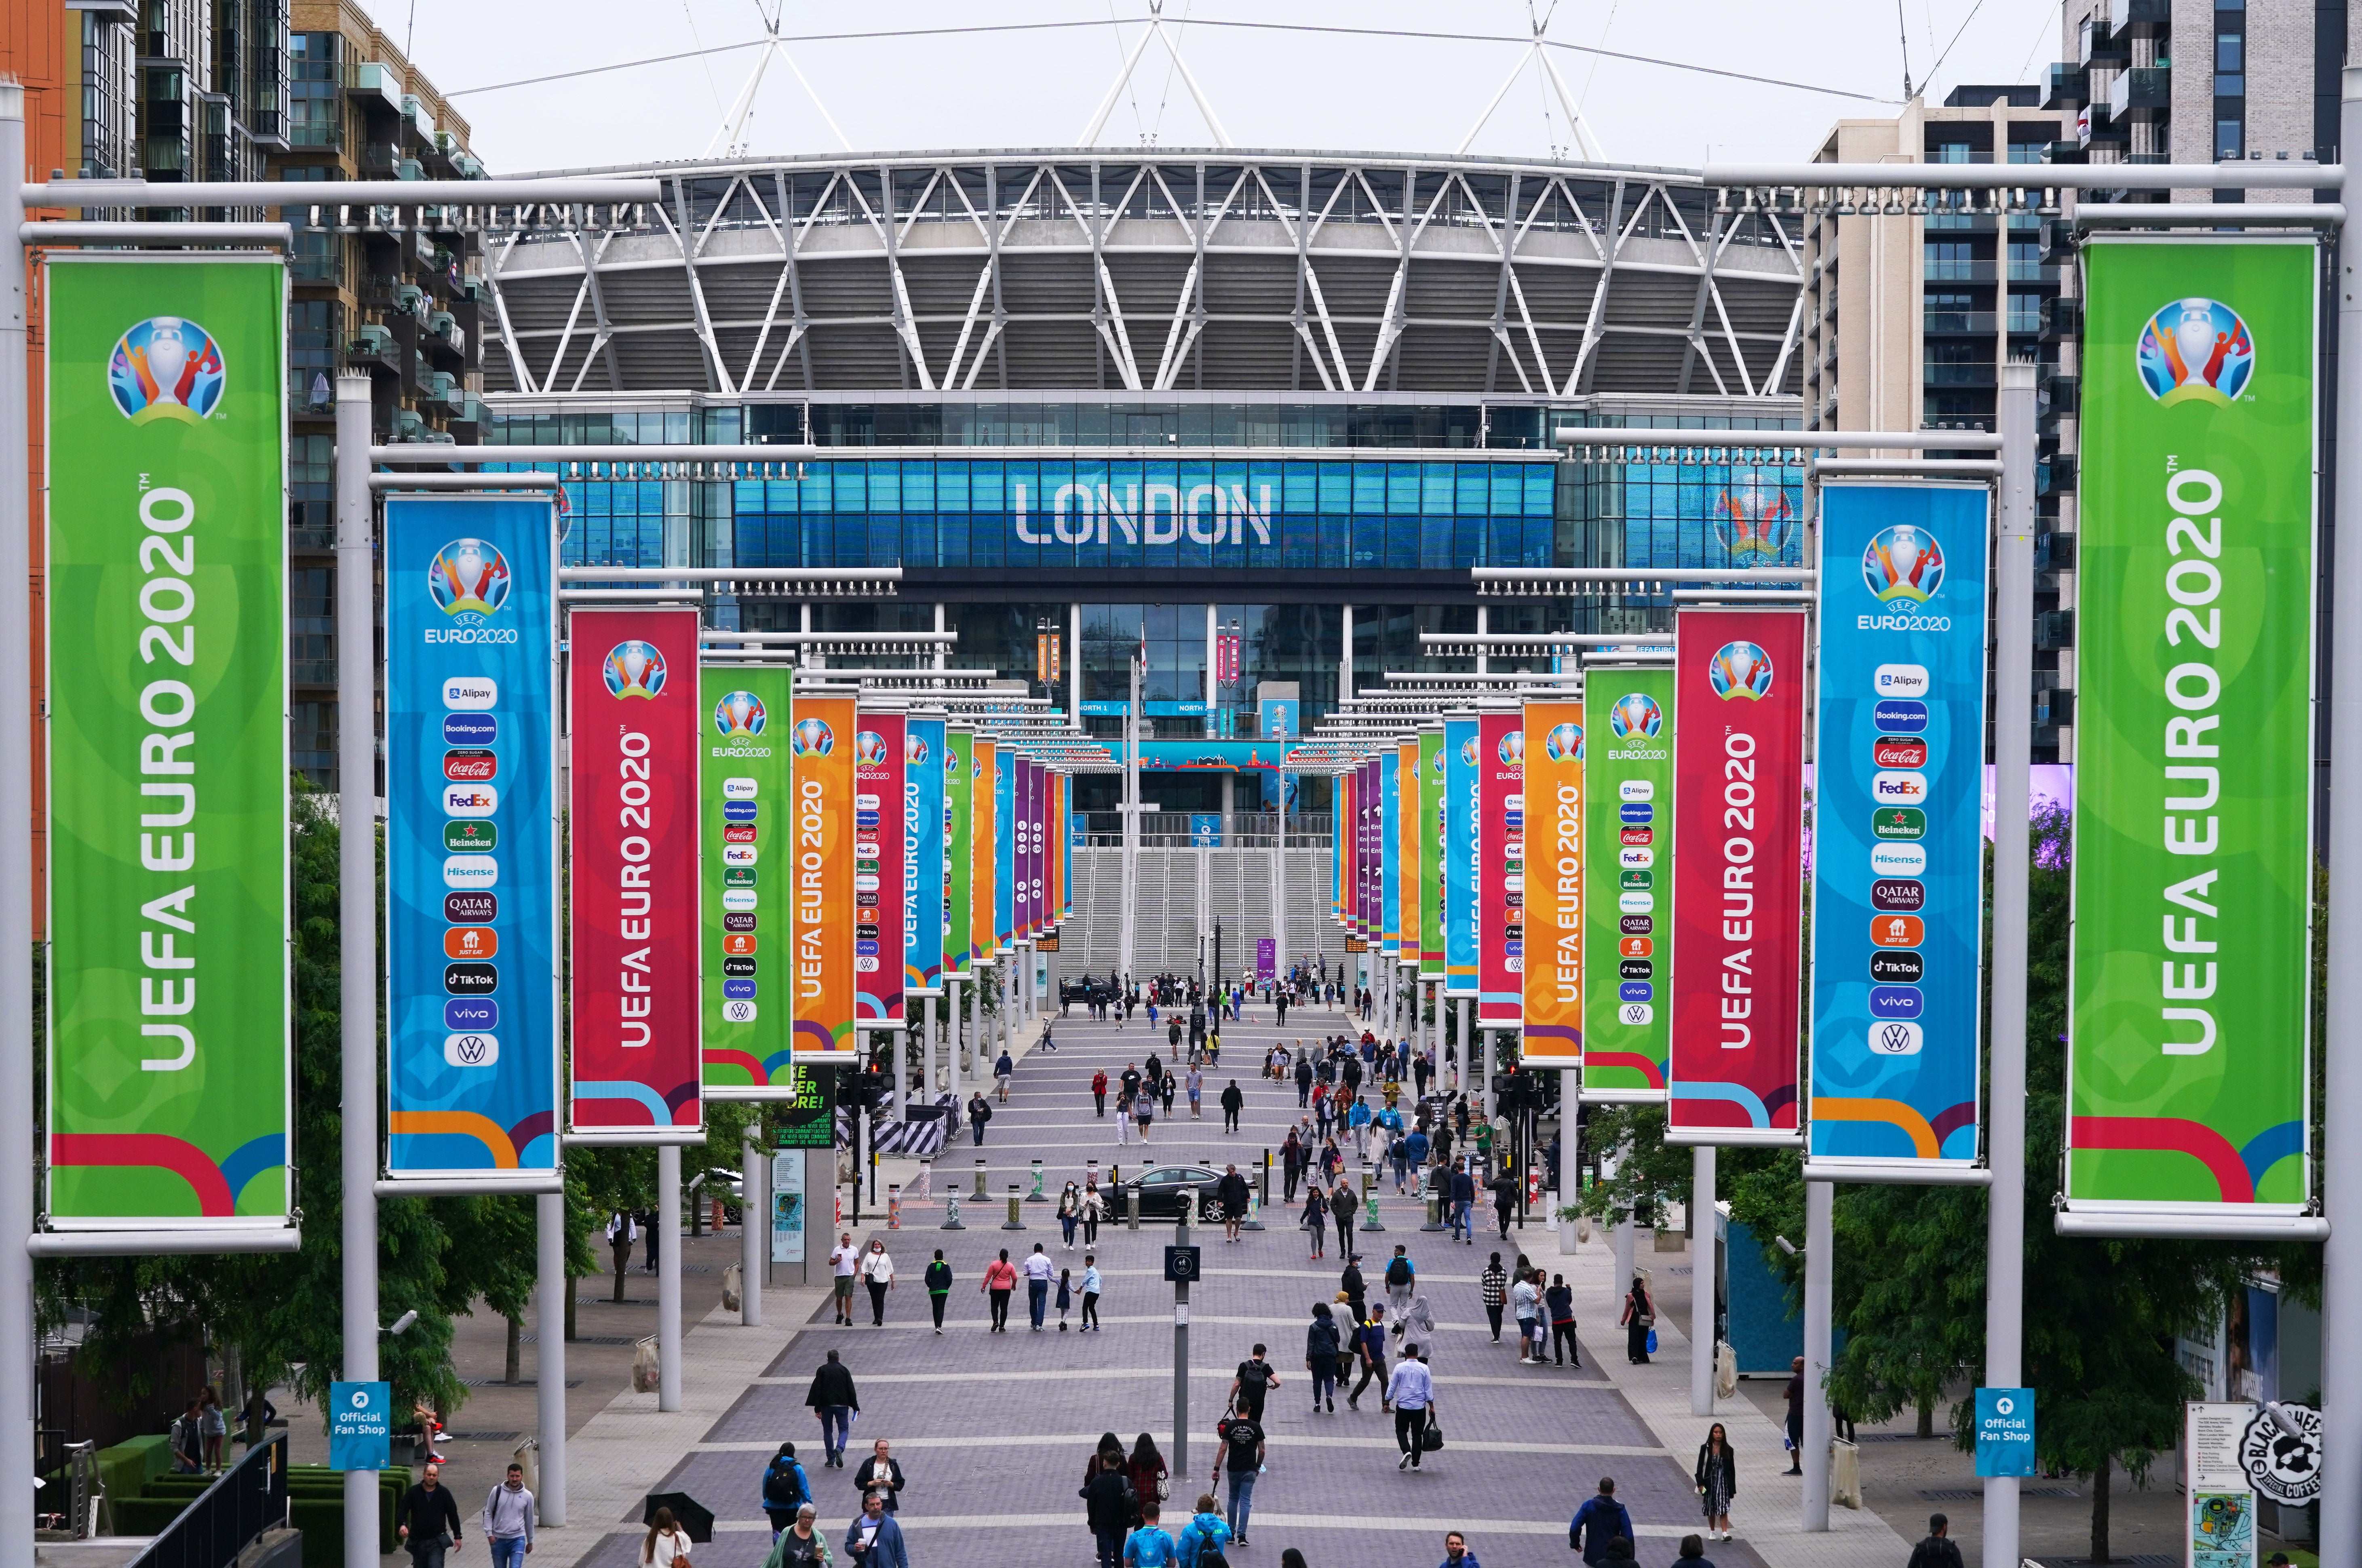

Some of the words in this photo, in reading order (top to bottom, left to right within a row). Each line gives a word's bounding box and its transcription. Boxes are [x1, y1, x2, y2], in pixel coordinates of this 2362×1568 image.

[1016, 484, 1270, 544] LONDON
[2166, 469, 2222, 649] 2020
[139, 487, 195, 666] 2020
[1888, 602, 1916, 612] UEFA
[456, 614, 483, 626] UEFA
[1858, 615, 1951, 631] EURO2020
[425, 629, 518, 644] EURO2020
[1894, 676, 1922, 686] Alipay
[462, 689, 491, 698] Alipay
[1877, 712, 1925, 721] Booking.com
[446, 725, 494, 733] Booking.com
[732, 738, 749, 746] UEFA
[1628, 741, 1645, 749] UEFA
[712, 747, 771, 757] EURO2020
[1608, 750, 1666, 759] EURO2020
[1878, 748, 1922, 763] Coca-Cola
[2164, 664, 2221, 855] EURO
[448, 762, 492, 776] Coca-Cola
[140, 680, 196, 872] EURO
[620, 732, 650, 828] 2020
[1725, 733, 1755, 830] 2020
[1879, 781, 1920, 794] FedEx
[450, 794, 491, 806] FedEx
[801, 781, 822, 847] 2020
[905, 782, 919, 833] 2020
[1558, 786, 1578, 852] 2020
[726, 831, 753, 840] Coca-Cola
[1878, 826, 1920, 834] Heineken
[450, 839, 491, 847] Heineken
[1623, 833, 1650, 843] Coca-Cola
[728, 851, 753, 859] FedEx
[1875, 855, 1922, 863] Hisense
[905, 837, 918, 891] EURO
[620, 836, 650, 940] EURO
[801, 852, 822, 923] EURO
[1558, 857, 1578, 928] EURO
[1723, 838, 1754, 941] EURO
[1877, 886, 1919, 898] QATAR
[449, 899, 491, 910] QATAR
[905, 894, 917, 947] UEFA
[801, 928, 822, 997] UEFA
[1557, 933, 1578, 1002] UEFA
[1885, 963, 1919, 973] TikTok
[2162, 868, 2218, 1055] UEFA
[141, 885, 196, 1071] UEFA
[460, 976, 493, 984] TikTok
[621, 947, 651, 1047] UEFA
[1721, 948, 1752, 1048] UEFA
[1879, 997, 1913, 1006] vivo
[454, 1009, 488, 1018] vivo
[340, 1412, 381, 1422] Official
[1985, 1419, 2026, 1428] Official
[335, 1425, 354, 1434] Fan
[358, 1425, 385, 1436] Shop
[1980, 1431, 1999, 1441] Fan
[2003, 1431, 2030, 1443] Shop
[2264, 1476, 2284, 1493] SPECIAL
